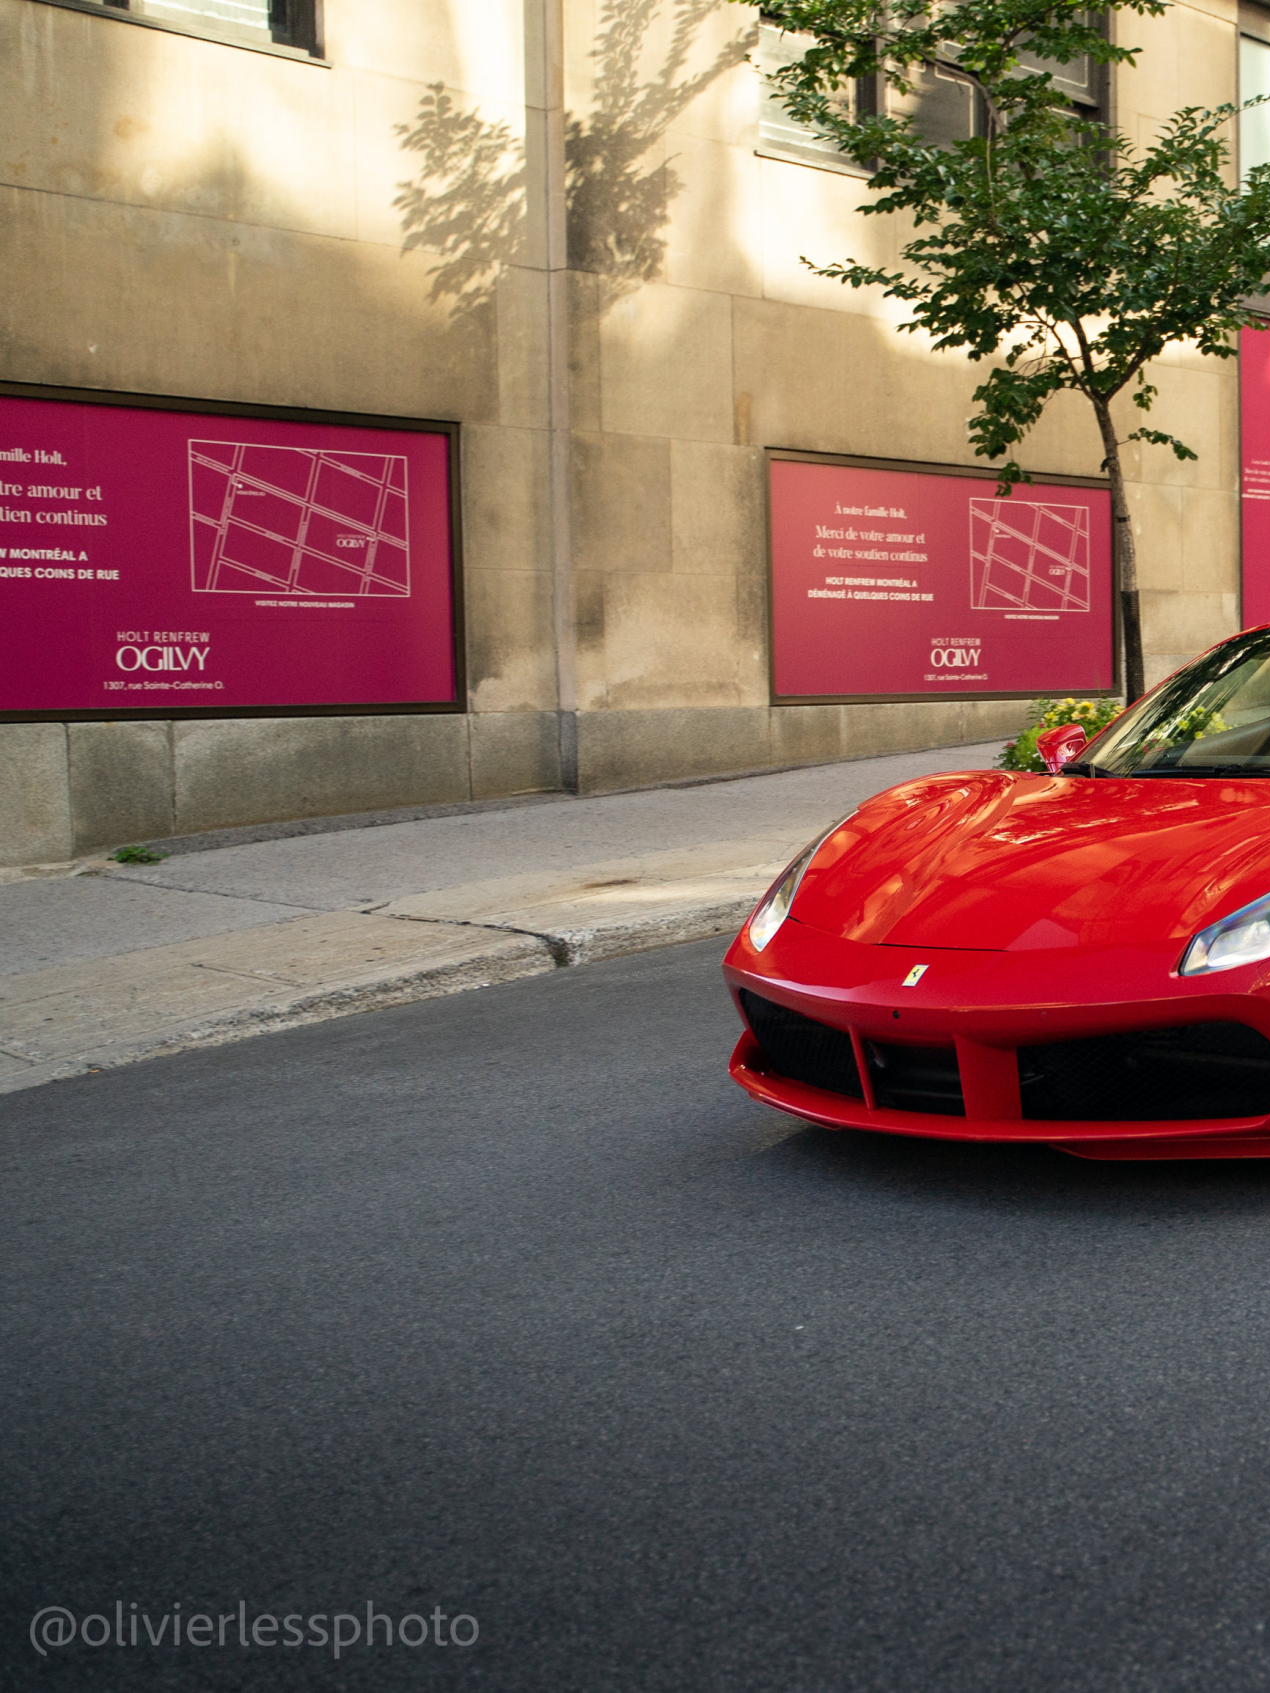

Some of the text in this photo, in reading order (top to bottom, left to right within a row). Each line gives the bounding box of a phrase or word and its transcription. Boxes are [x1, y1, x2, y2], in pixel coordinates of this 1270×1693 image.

[27, 485, 83, 500] amour
[86, 486, 103, 501] et
[36, 510, 108, 527] continus
[816, 525, 925, 544] Merci de votre amour et
[9, 547, 77, 561] MONTRÉAL
[78, 550, 88, 561] A
[813, 544, 928, 562] de votre soutien continus
[34, 568, 75, 580] COINS
[77, 569, 94, 580] DE
[96, 570, 120, 581] RUE
[116, 631, 210, 644] HOLT RENFREW
[115, 645, 211, 672] OGILVY
[930, 648, 982, 667] OGILVY
[128, 682, 142, 690] rue
